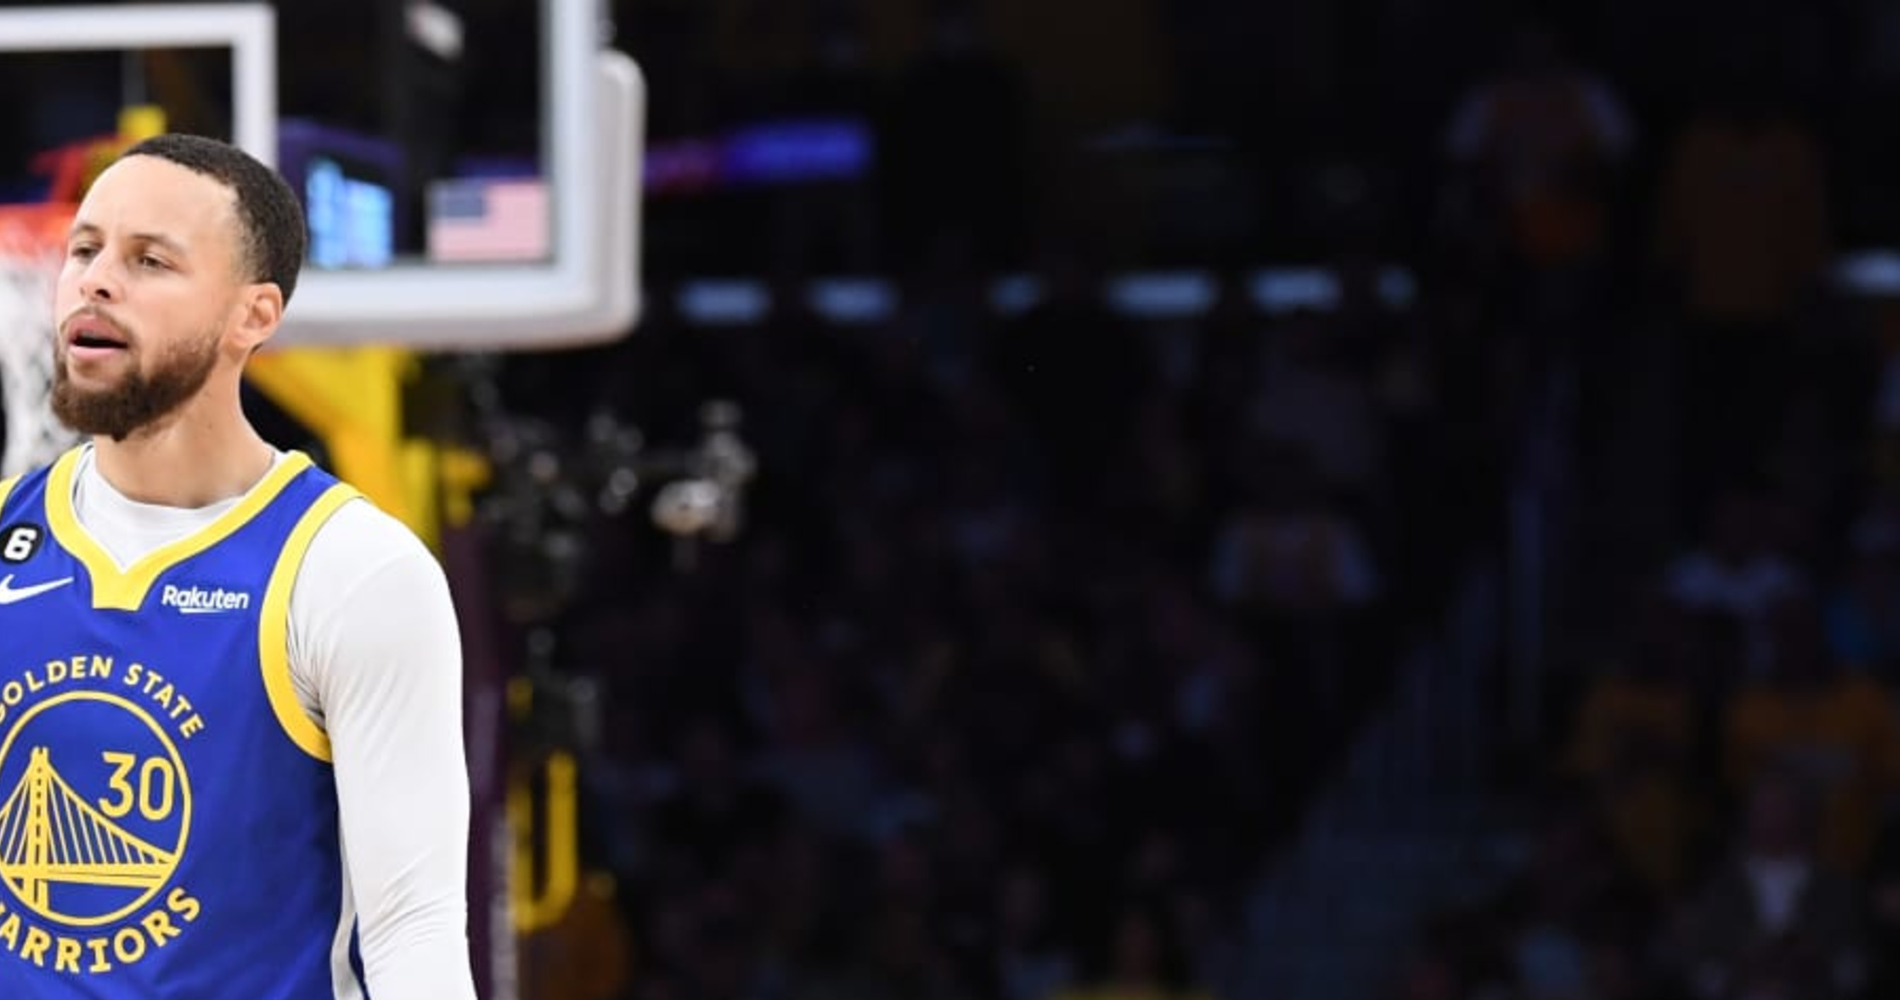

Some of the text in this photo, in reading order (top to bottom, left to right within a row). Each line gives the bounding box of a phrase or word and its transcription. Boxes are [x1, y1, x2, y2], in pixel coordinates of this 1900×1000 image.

[3, 526, 38, 562] 6
[160, 583, 250, 611] Rakuten
[124, 663, 206, 739] STATE
[98, 750, 176, 821] 30
